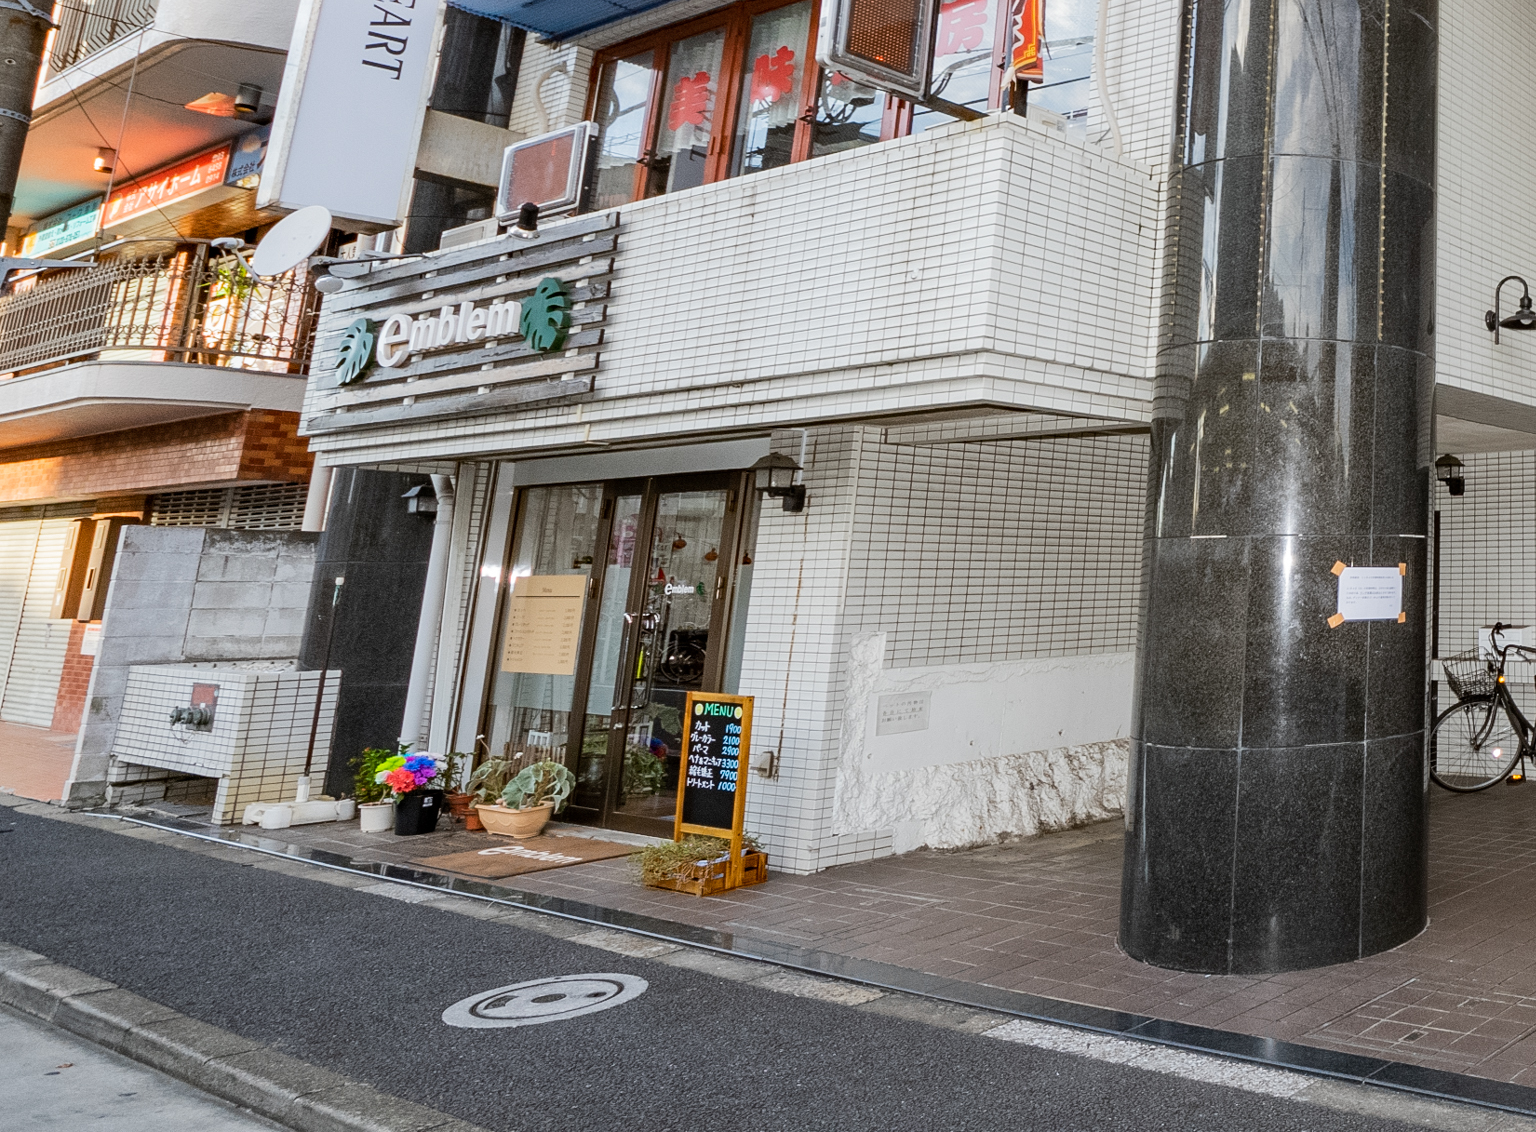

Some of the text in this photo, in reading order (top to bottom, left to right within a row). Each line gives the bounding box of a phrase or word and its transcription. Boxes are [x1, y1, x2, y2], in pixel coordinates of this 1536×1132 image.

[135, 165, 201, 208] アサイホーム
[377, 301, 522, 367] emblem
[664, 583, 694, 595] emblem
[704, 703, 734, 717] MENU
[695, 720, 710, 732] カット
[723, 735, 740, 746] 2100
[721, 758, 739, 768] 3300
[687, 777, 737, 792] トリートメント 1000
